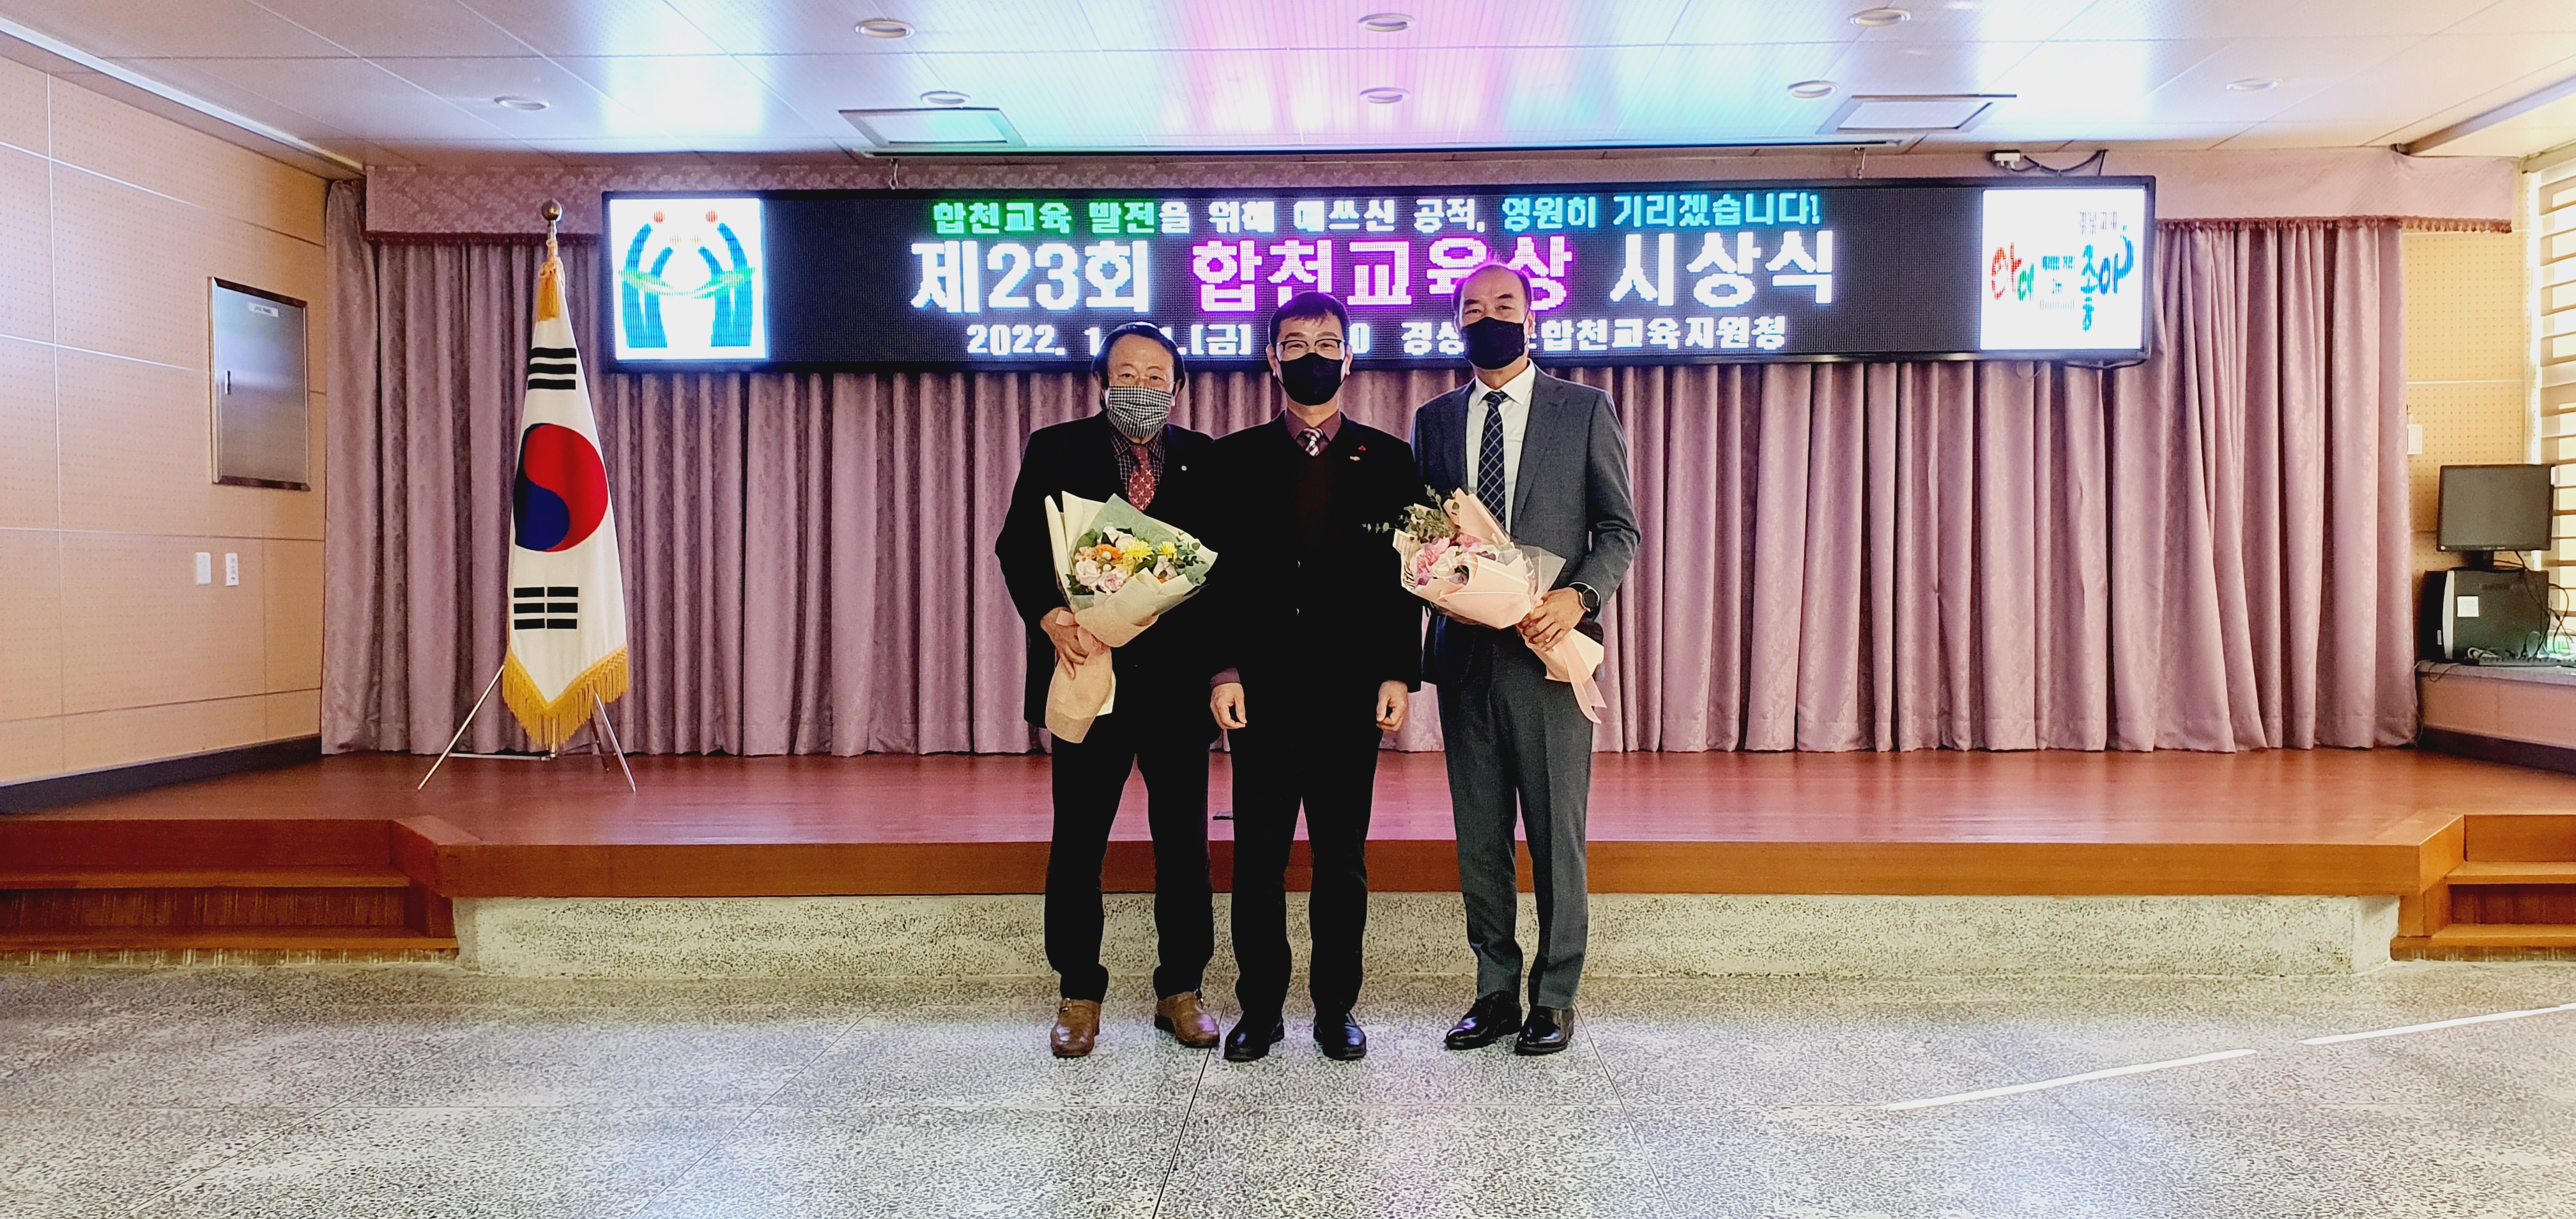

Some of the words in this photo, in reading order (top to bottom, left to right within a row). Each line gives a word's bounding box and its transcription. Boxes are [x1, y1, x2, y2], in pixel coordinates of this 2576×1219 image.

[933, 202, 1072, 234] 합천교육
[1089, 202, 1190, 234] 발전을
[1209, 201, 1275, 233] 위해
[1413, 199, 1485, 233] 공적,
[1502, 197, 1596, 232] 영원히
[1613, 192, 1820, 227] 기리겠습니다!
[910, 240, 1149, 313] 제23회
[1609, 230, 1833, 308] 시상식
[966, 324, 1066, 356] 2022.
[1401, 316, 1786, 356] 경상합천교육지원청
